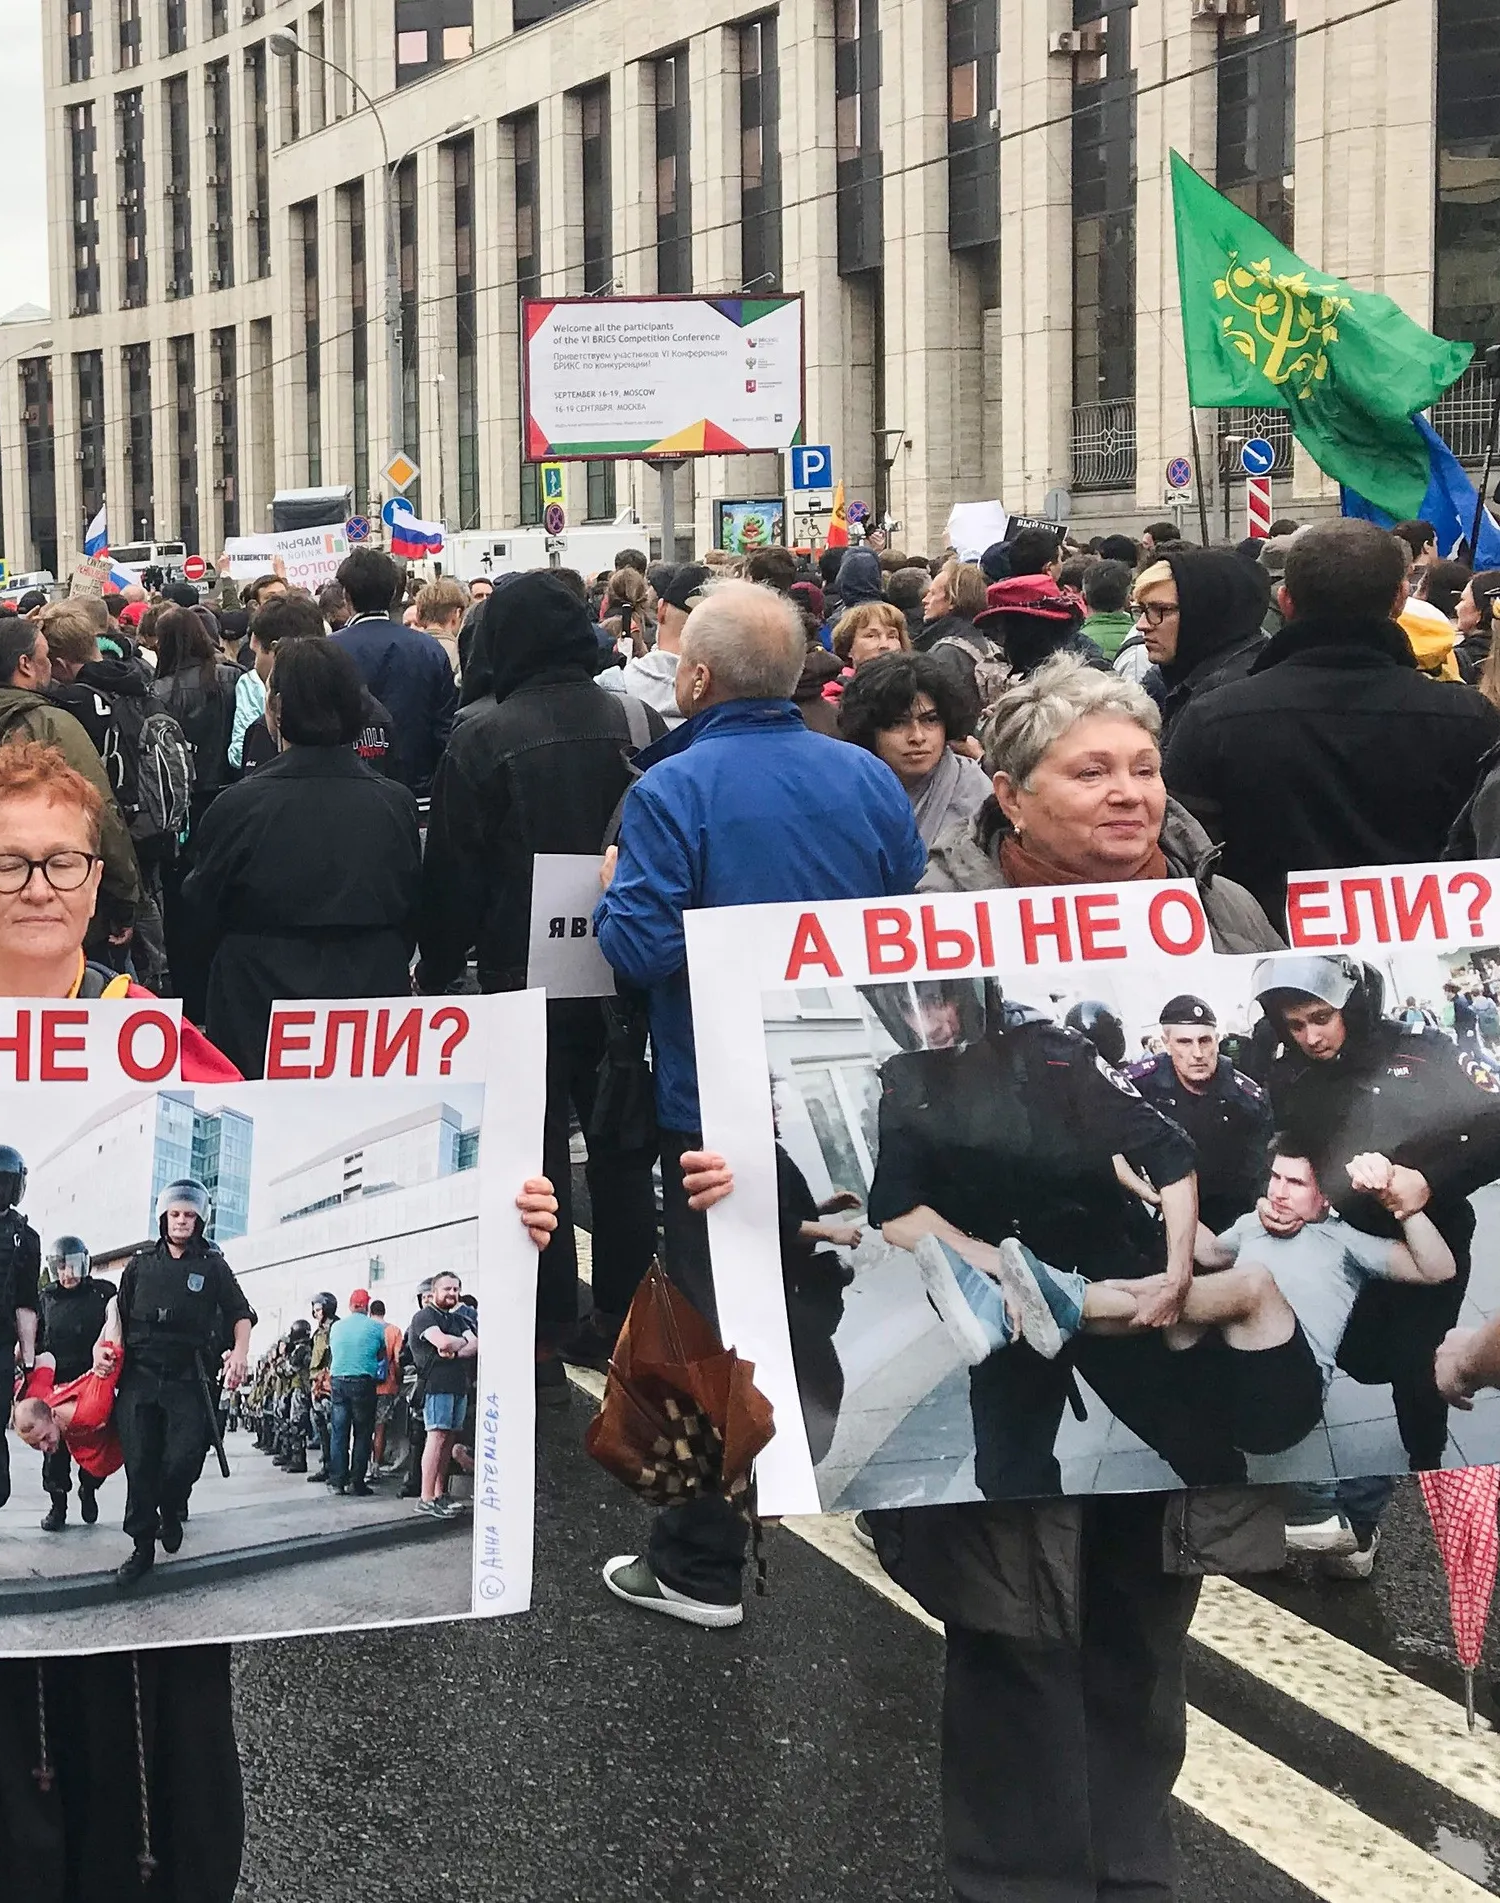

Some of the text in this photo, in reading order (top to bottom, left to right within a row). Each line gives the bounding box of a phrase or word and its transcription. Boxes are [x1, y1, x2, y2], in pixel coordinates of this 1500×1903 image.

[553, 322, 674, 332] Welcome all the participants
[553, 336, 562, 344] of
[565, 335, 579, 344] the
[592, 335, 616, 343] BRICS
[618, 333, 670, 344] Competition
[672, 333, 720, 342] Conference
[553, 352, 611, 361] Приветствуем
[613, 351, 660, 360] участников
[672, 350, 728, 359] Конференции
[553, 361, 580, 370] БРИКС
[595, 360, 651, 370] конкуренции!
[554, 390, 596, 399] SEPTEMBER
[623, 389, 656, 397] MOSCOW
[617, 402, 646, 411] МОСКВА
[785, 912, 843, 980] А
[863, 901, 995, 975] ВЫ
[1019, 893, 1127, 965] НЕ
